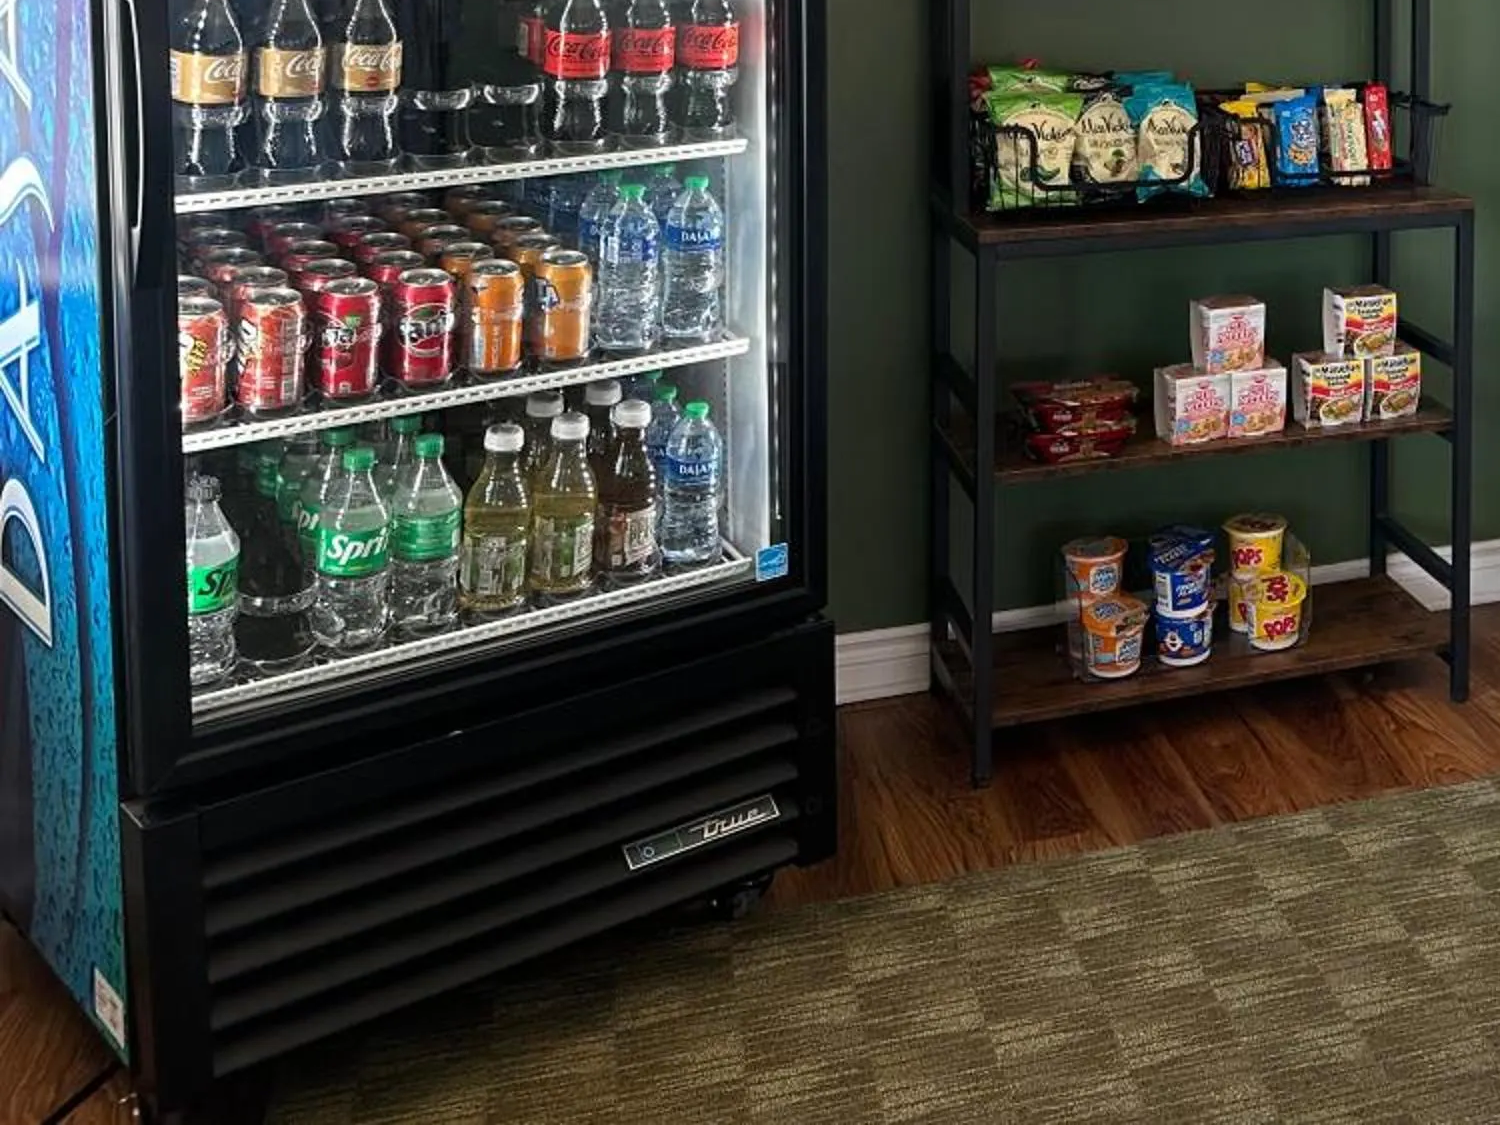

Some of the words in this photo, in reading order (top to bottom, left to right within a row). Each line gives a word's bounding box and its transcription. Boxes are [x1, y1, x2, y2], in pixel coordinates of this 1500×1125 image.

[681, 229, 719, 243] DASAN
[679, 462, 718, 477] DASAN
[326, 526, 389, 566] Spri
[1263, 614, 1298, 642] POPS
[689, 807, 767, 839] True
